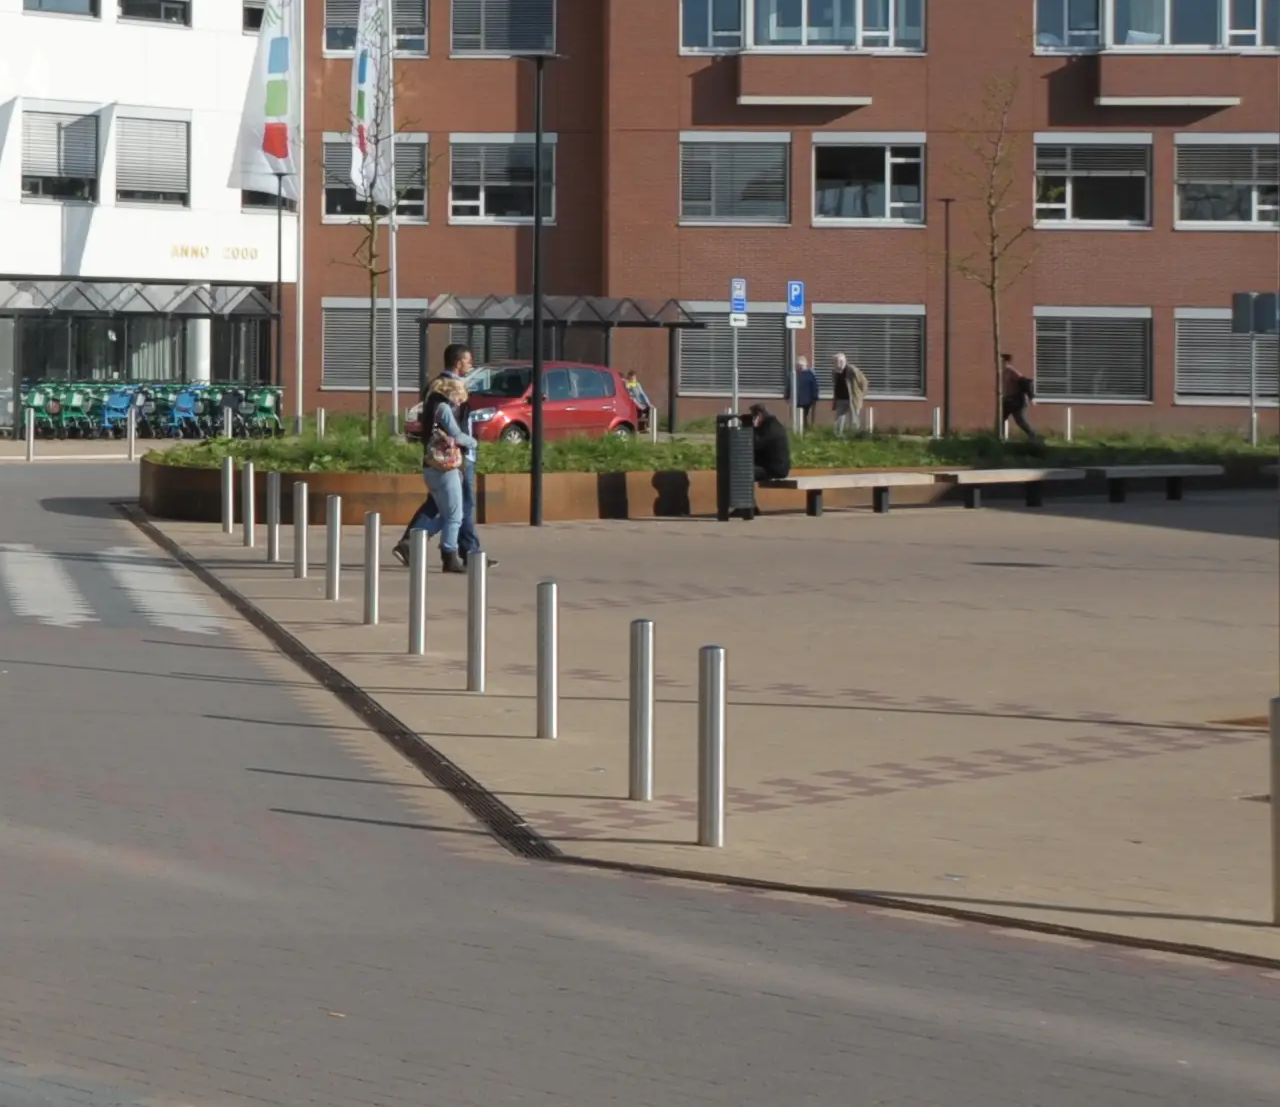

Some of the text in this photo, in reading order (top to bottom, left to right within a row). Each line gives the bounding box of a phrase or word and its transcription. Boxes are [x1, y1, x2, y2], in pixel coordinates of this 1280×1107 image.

[170, 244, 259, 261] ANNO 2000
[791, 283, 801, 302] P
